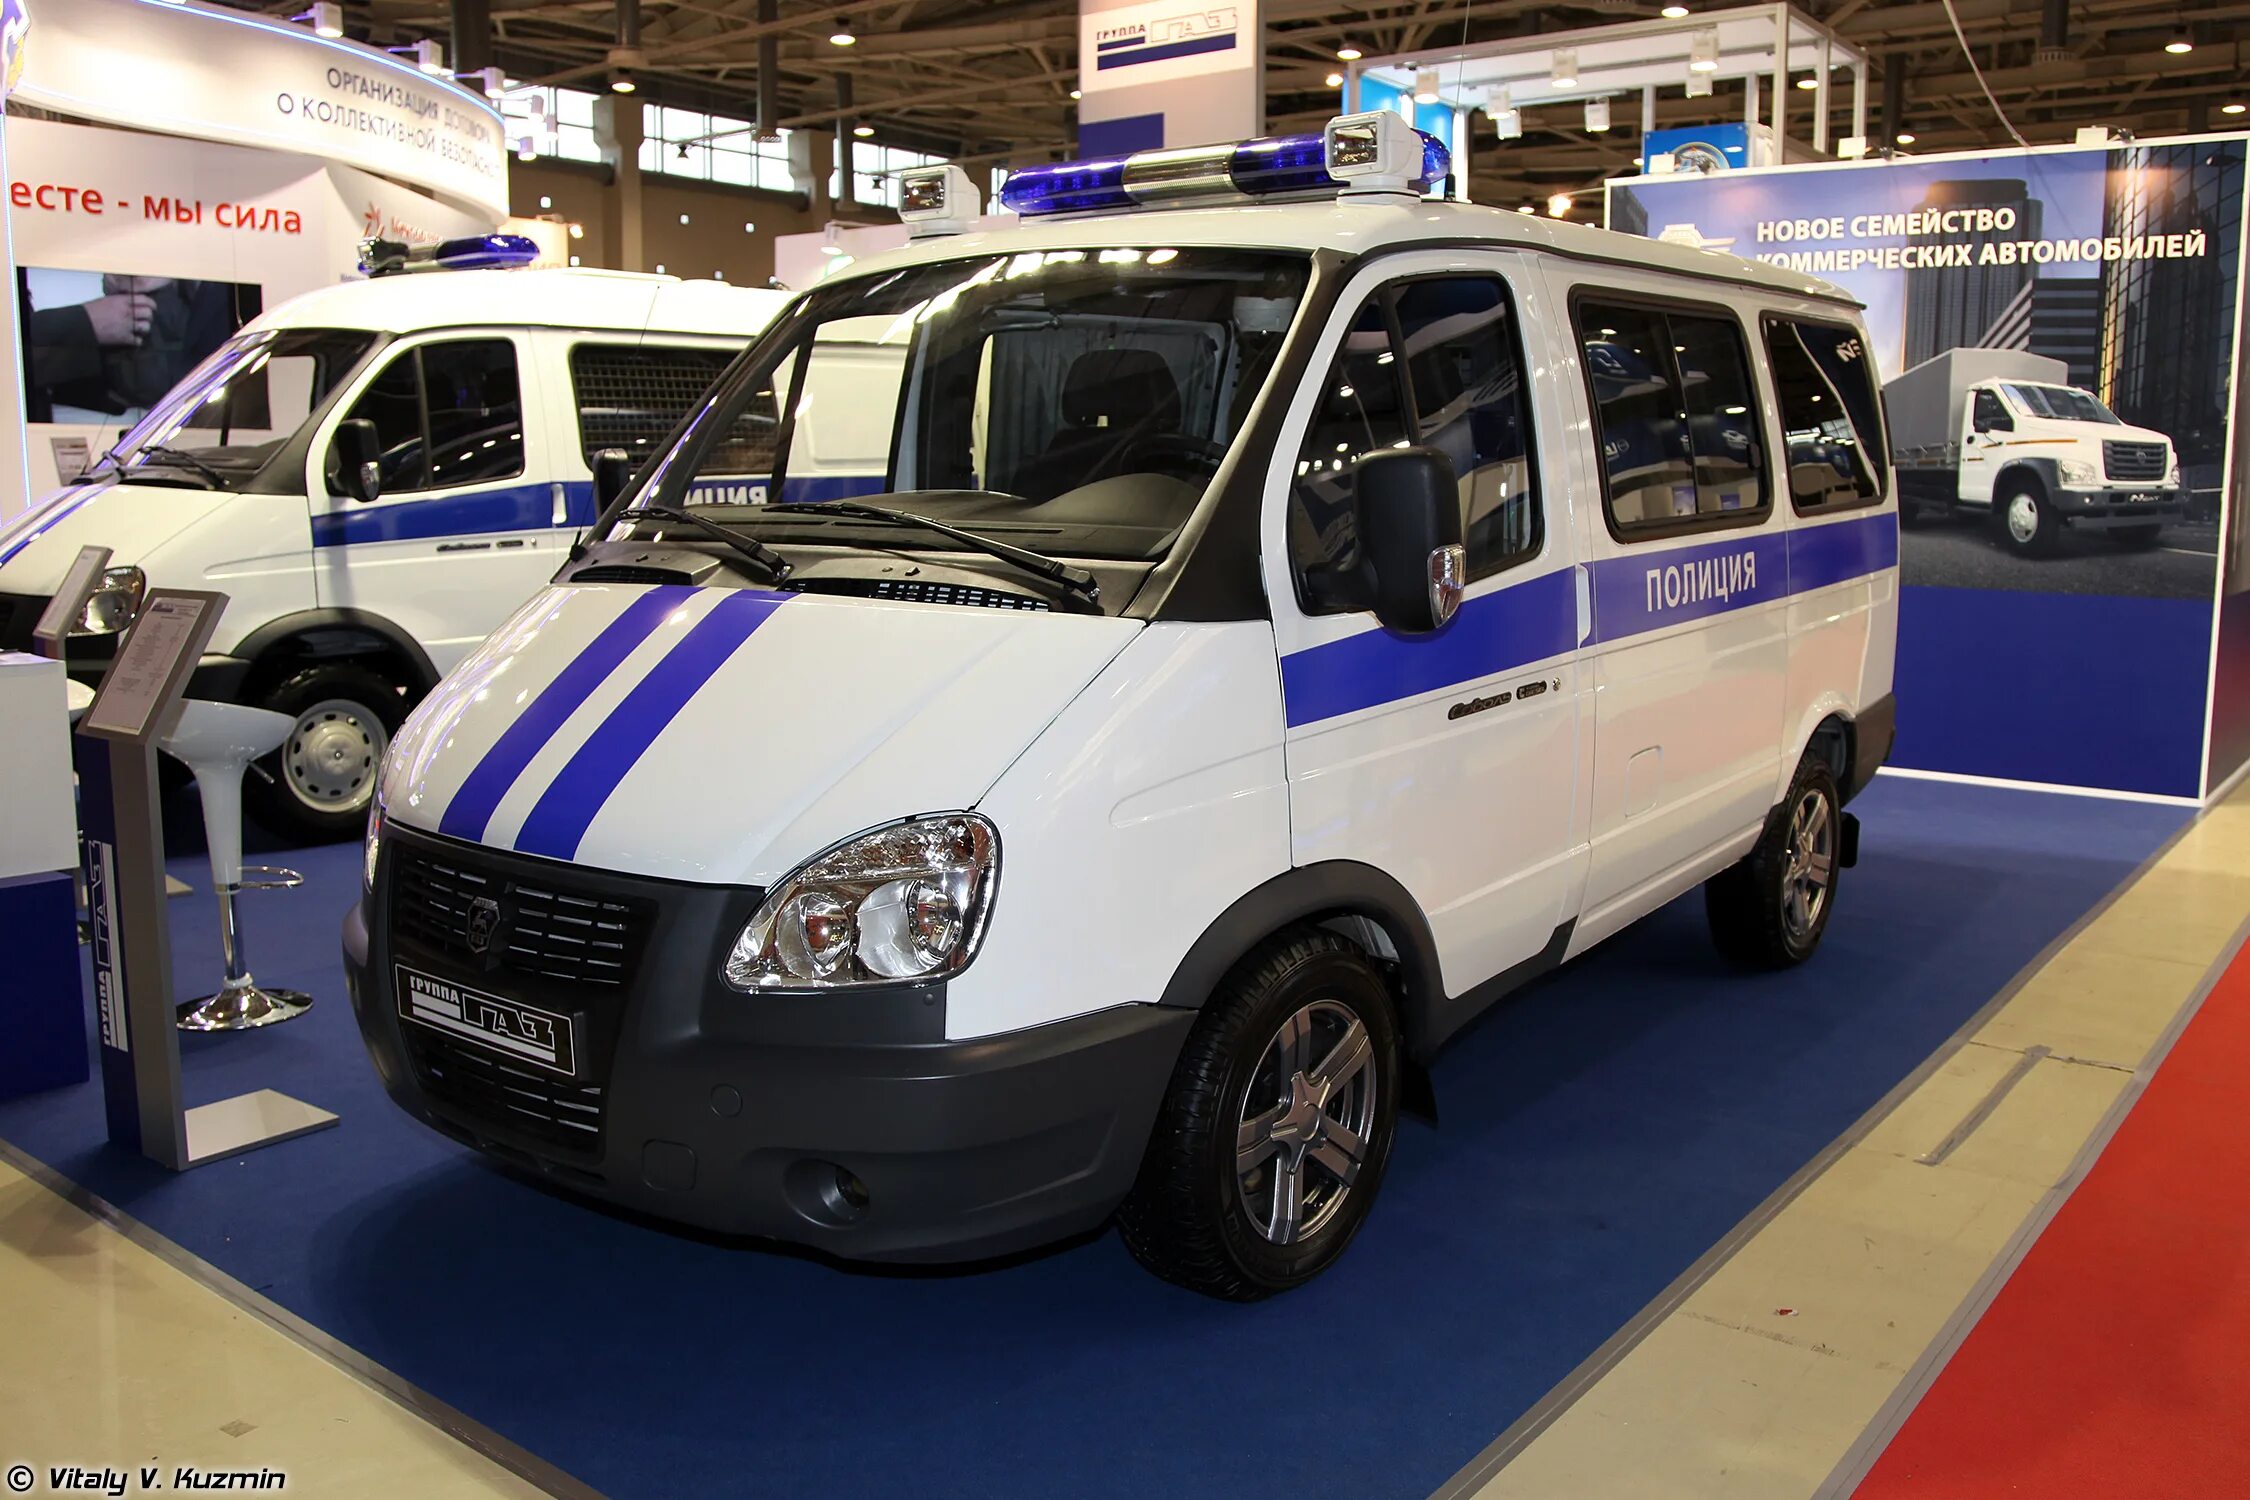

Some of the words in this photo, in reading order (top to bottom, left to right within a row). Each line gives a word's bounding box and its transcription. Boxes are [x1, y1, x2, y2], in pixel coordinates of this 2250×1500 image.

[1096, 24, 1147, 41] ГРУППА
[1151, 6, 1237, 42] ГАЗ
[326, 67, 439, 119] ОРГАНИЗАЦИЯ
[277, 92, 294, 114] О
[302, 97, 435, 153] КОЛЛЕКТИВНОЙ
[143, 195, 202, 225] мы
[215, 202, 302, 233] сила
[1756, 217, 1845, 243] НОВОЕ
[1850, 207, 2016, 238] СЕМЕЙСТВО
[1978, 228, 2207, 266] АВТОМОБИЛЕЙ
[1646, 551, 1757, 612] ПОЛИЦИЯ
[88, 839, 111, 967] ГАЗ
[98, 970, 112, 1046] ГРУППА
[409, 975, 462, 1004] ГРУППА
[462, 992, 556, 1051] ГАЗ
